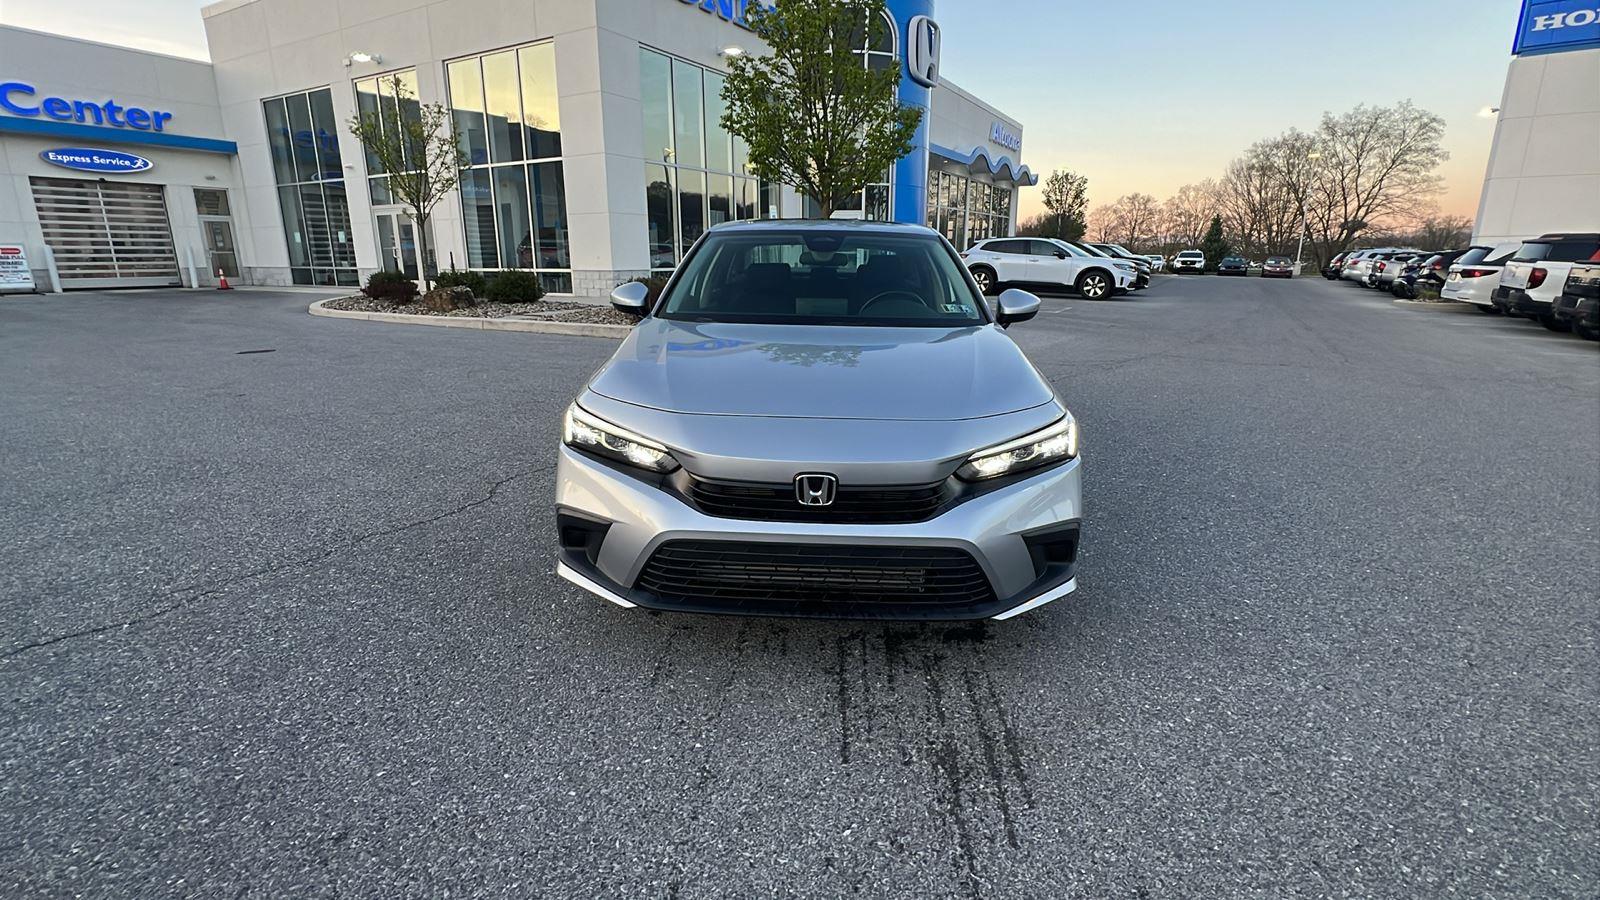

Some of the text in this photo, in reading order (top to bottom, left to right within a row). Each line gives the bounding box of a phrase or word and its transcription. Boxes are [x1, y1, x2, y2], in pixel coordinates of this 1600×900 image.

[1531, 9, 1600, 31] HO
[0, 82, 172, 132] Center
[48, 152, 131, 166] Express Service
